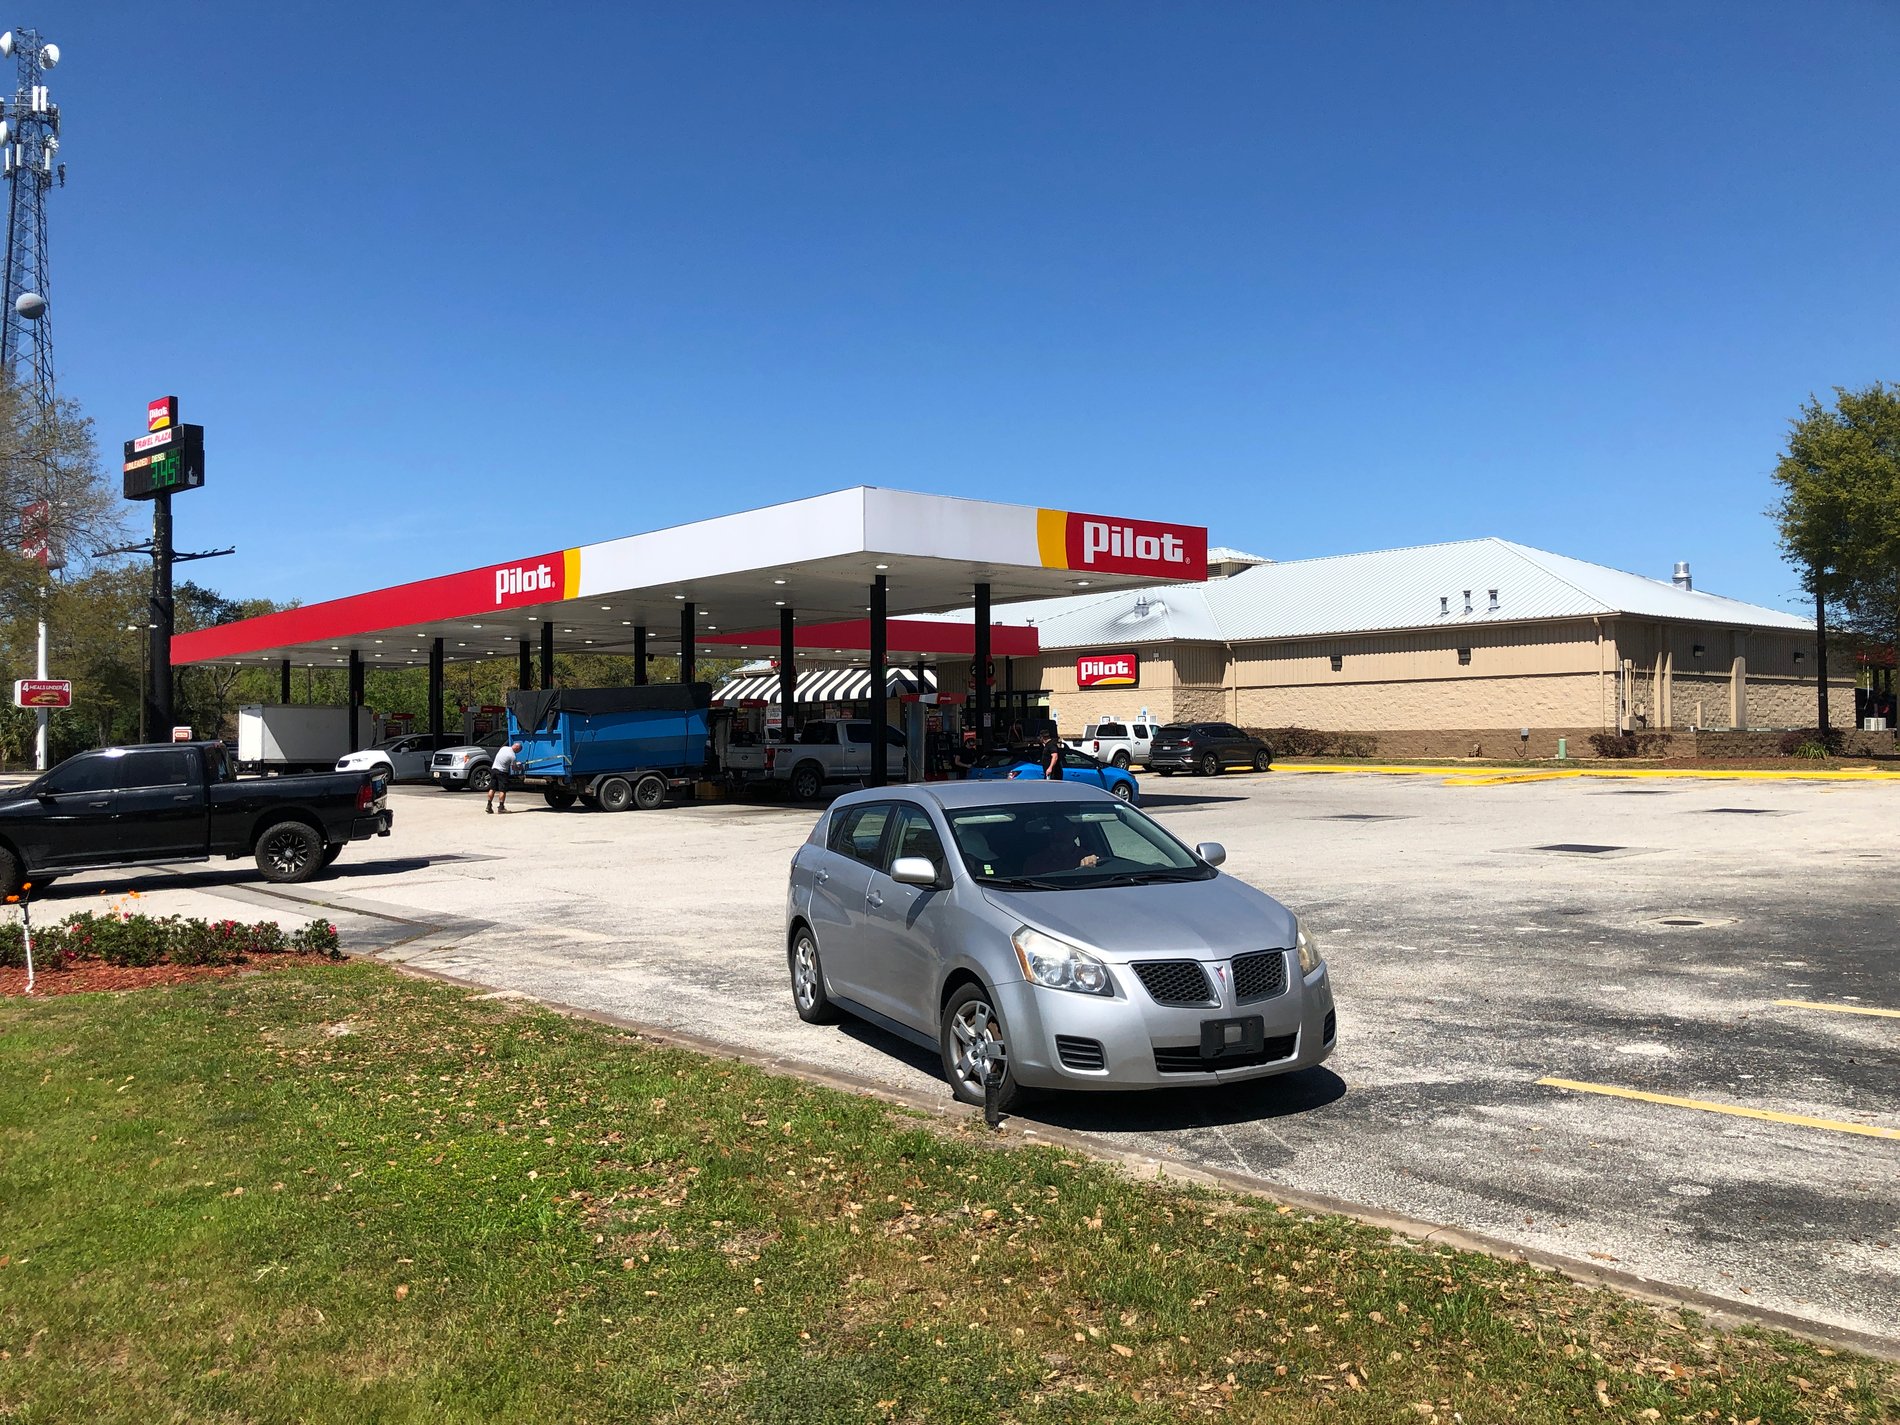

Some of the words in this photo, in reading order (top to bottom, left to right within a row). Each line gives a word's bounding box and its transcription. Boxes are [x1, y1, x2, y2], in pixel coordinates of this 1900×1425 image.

[149, 406, 168, 422] Pilot
[135, 437, 154, 449] TRAVEL
[155, 432, 171, 443] PLAZA
[1083, 521, 1184, 564] Pilot
[495, 564, 551, 605] Pilot
[1081, 660, 1129, 681] Pilot
[22, 682, 29, 692] 4
